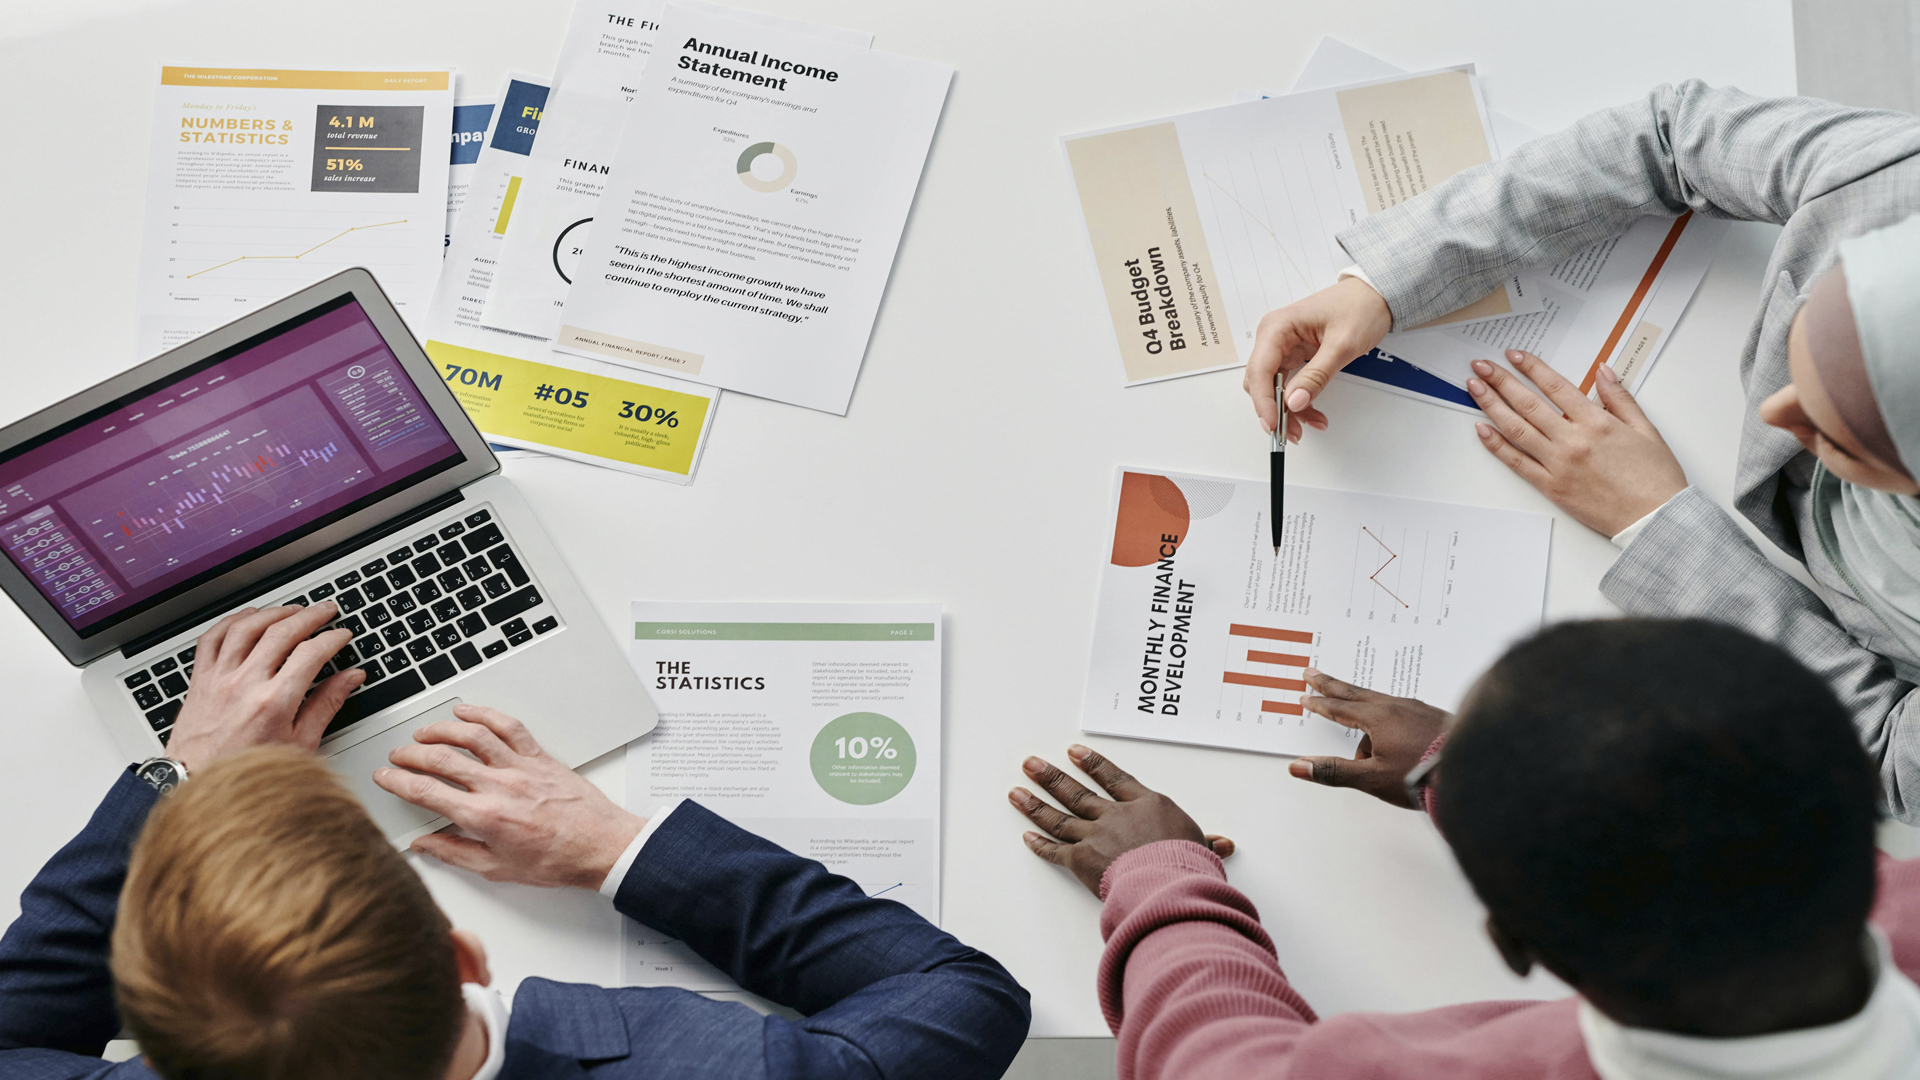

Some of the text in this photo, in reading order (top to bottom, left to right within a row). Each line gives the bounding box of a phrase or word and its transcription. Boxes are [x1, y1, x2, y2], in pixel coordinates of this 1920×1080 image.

[608, 14, 634, 27] THE
[682, 37, 838, 82] Annual Income
[677, 55, 787, 91] Statement
[667, 86, 738, 106] expenditures for Q4
[677, 78, 711, 91] summary
[731, 91, 770, 103] company's
[770, 99, 802, 110] earnings
[181, 102, 214, 111] Monday
[225, 103, 257, 112] Friday's
[181, 117, 293, 131] NUMBERS &
[329, 115, 374, 128] 4.1 M
[179, 131, 288, 145] STATISTICS
[326, 131, 346, 139] total
[712, 126, 749, 139] Expeditures
[326, 158, 363, 172] 51%
[344, 174, 376, 182] increase
[559, 177, 596, 189] This graph
[790, 188, 818, 199] Earnings
[474, 257, 497, 265] AUDIT
[615, 245, 826, 299] "This is the highest income growth we have
[1180, 260, 1193, 291] company
[609, 260, 829, 314] seen in the shortest amount of time. We shall
[1513, 275, 1523, 298] ANNUAL
[604, 273, 809, 323] continue to employ the current strategy."
[1147, 246, 1186, 351] Breakdown
[1188, 291, 1196, 302] the
[1199, 284, 1209, 305] equity
[1125, 258, 1163, 355] Q4 Budget
[1204, 305, 1216, 331] owner's
[1194, 310, 1207, 341] summary
[1210, 331, 1220, 345] and
[574, 336, 599, 345] ANNUAL
[601, 342, 633, 353] FINANCIAL
[635, 349, 659, 358] REPORT
[1621, 357, 1635, 377] REPORT
[1634, 341, 1646, 355] PAGE
[445, 364, 503, 391] 70M
[534, 383, 589, 409] #05
[522, 411, 563, 424] manufacturing
[527, 405, 547, 414] Several
[547, 410, 576, 419] operations
[618, 400, 679, 428] 30%
[529, 419, 556, 429] corporate
[629, 427, 650, 436] usually
[624, 440, 656, 450] publication
[168, 450, 188, 461] Trade
[1138, 533, 1179, 714] MONTHLY FINANCE
[1161, 579, 1196, 716] DEVELOPMENT
[656, 661, 690, 674] THE
[656, 676, 765, 690] STATISTICS
[835, 736, 897, 759] 10%
[858, 771, 891, 779] stakeholders
